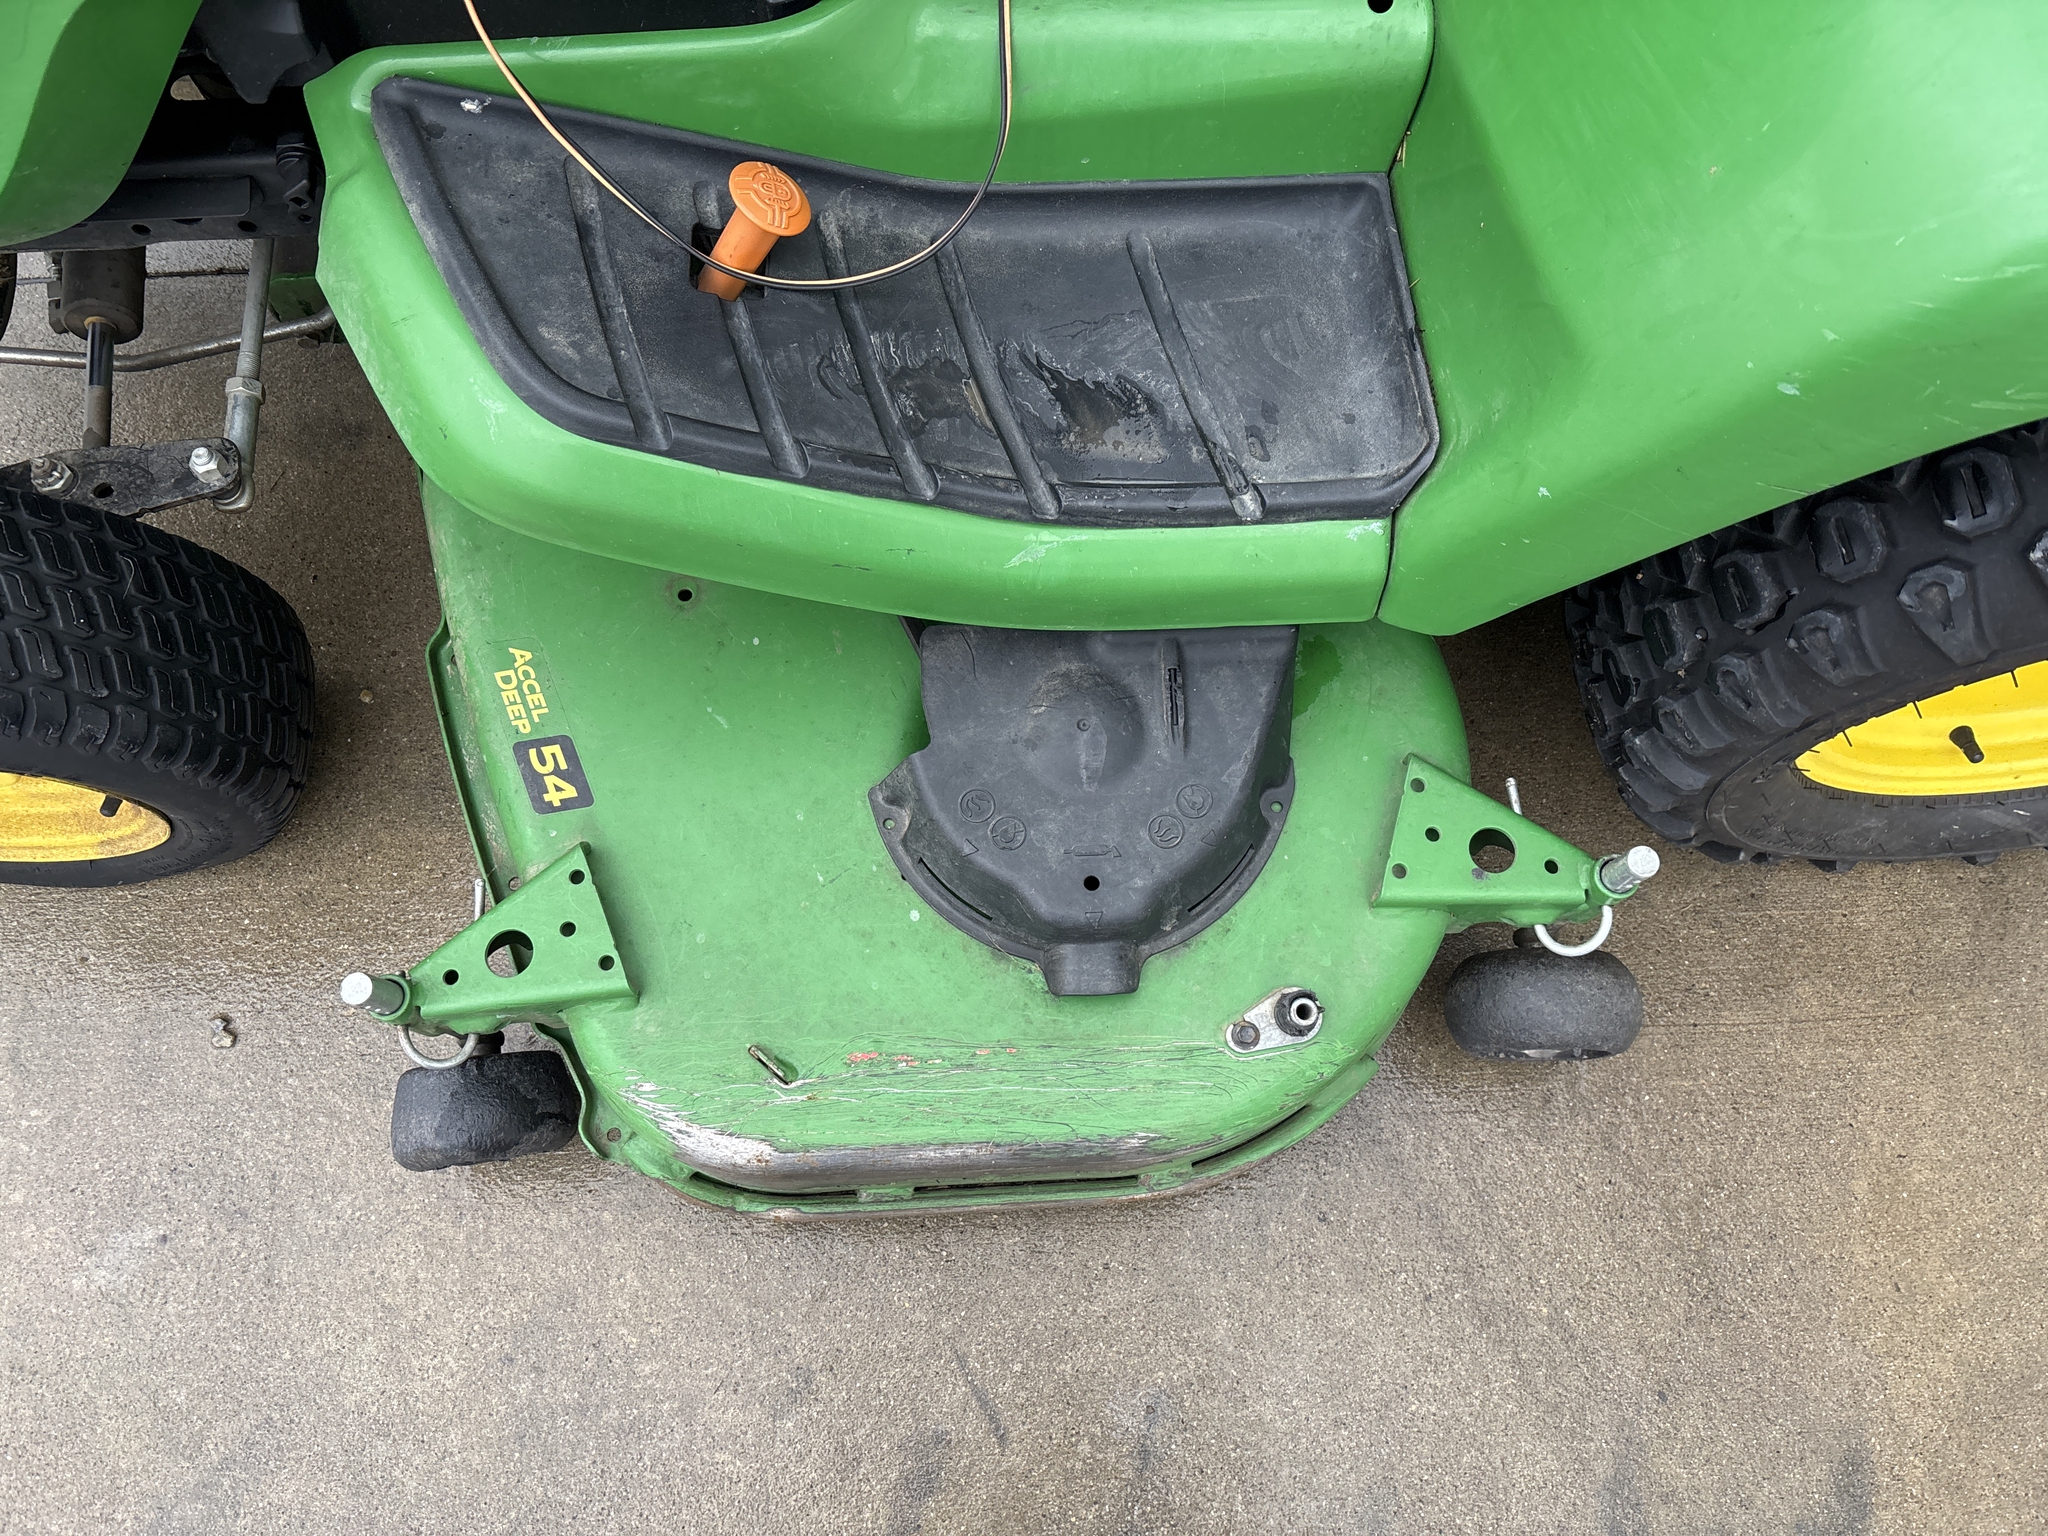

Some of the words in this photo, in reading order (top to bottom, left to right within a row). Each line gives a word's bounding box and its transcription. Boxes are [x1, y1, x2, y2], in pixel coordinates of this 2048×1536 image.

[494, 669, 532, 734] DEEP
[508, 647, 549, 723] ACCEL
[528, 744, 578, 807] 54
